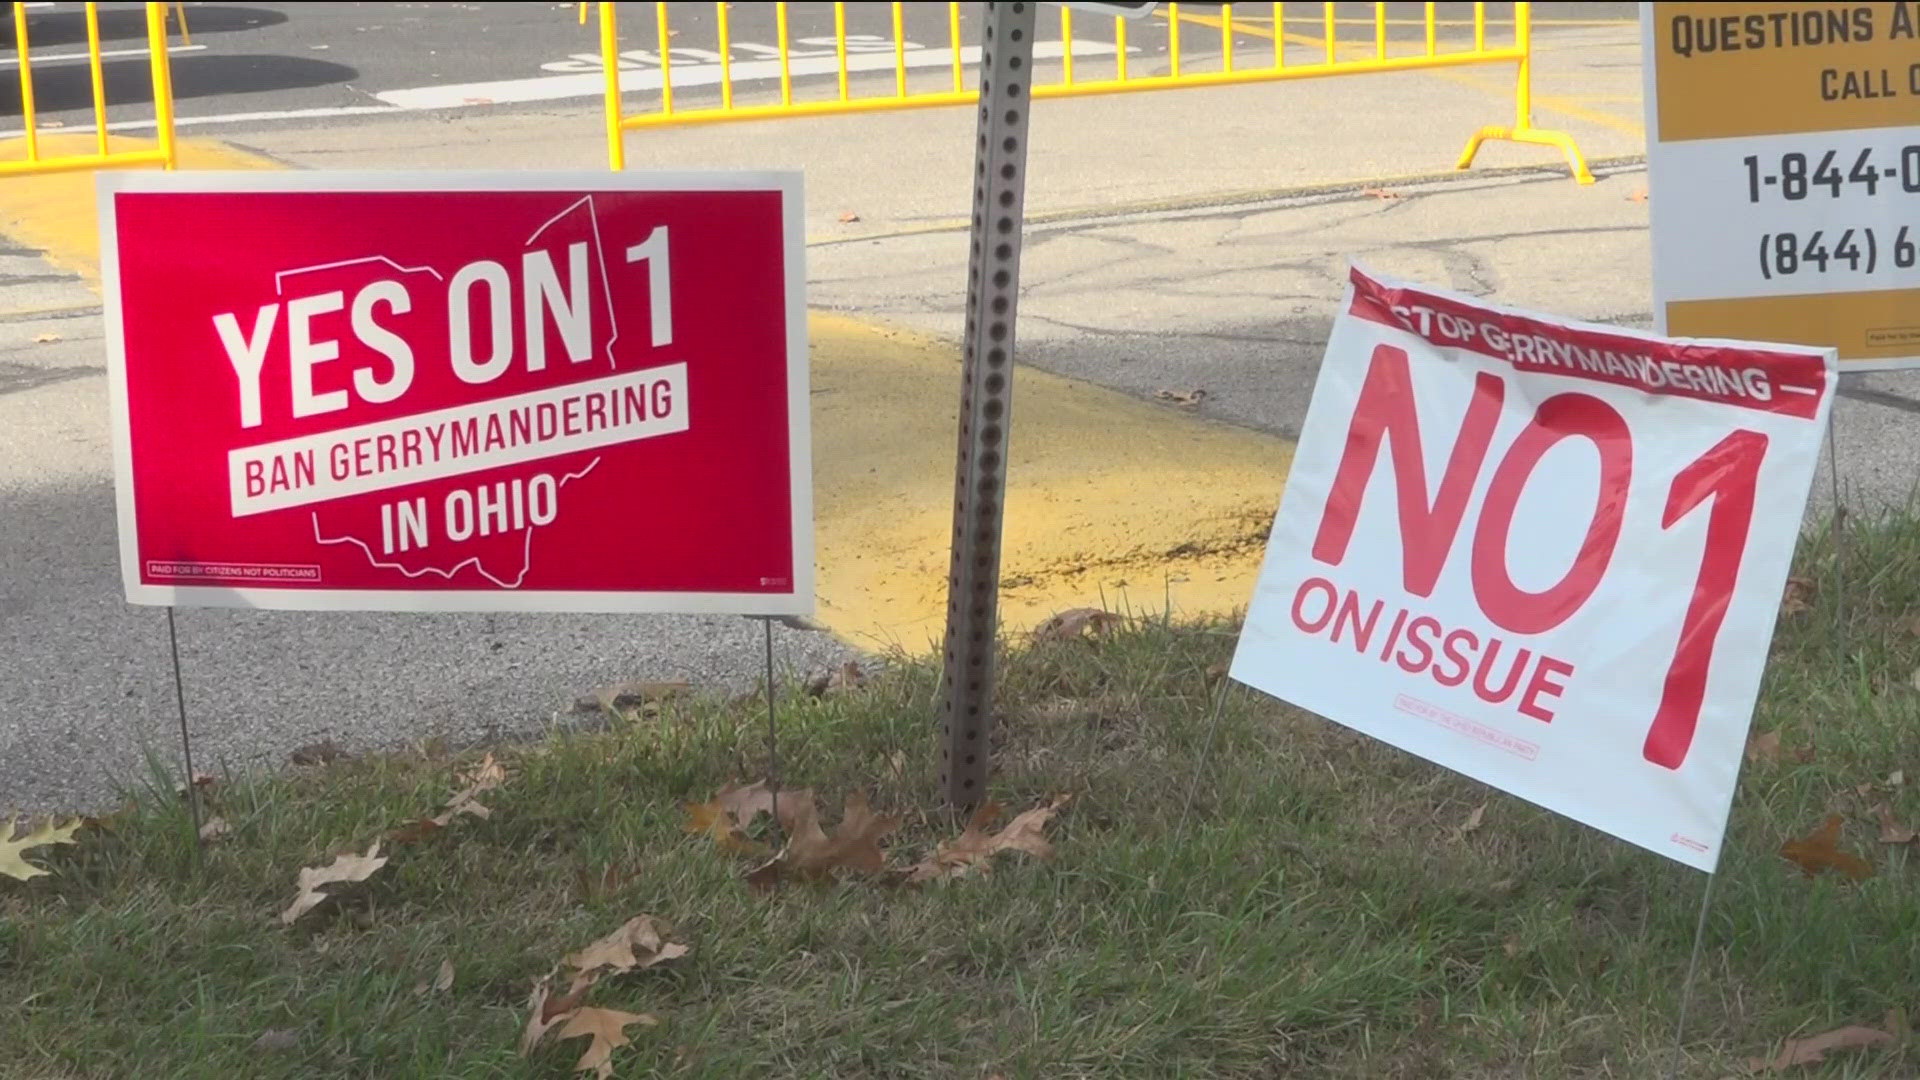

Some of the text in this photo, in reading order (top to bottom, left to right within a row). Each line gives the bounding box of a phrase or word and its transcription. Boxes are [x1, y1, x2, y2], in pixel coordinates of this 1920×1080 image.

[1671, 7, 1873, 58] QUESTIONS
[1820, 68, 1897, 101] CALL
[1759, 225, 1920, 280] (844) 6
[213, 225, 674, 429] YES ON 1
[1389, 305, 1476, 343] STOP
[245, 378, 673, 498] BAN GERRYMANDERING
[380, 473, 558, 555] IN OHIO
[1311, 343, 1633, 636] NO
[151, 564, 317, 578] PAID FOR BY CITIZENS NOT POLITICIANS
[1290, 577, 1385, 654] ON
[1380, 608, 1575, 724] ISSUE
[1642, 428, 1769, 771] 1
